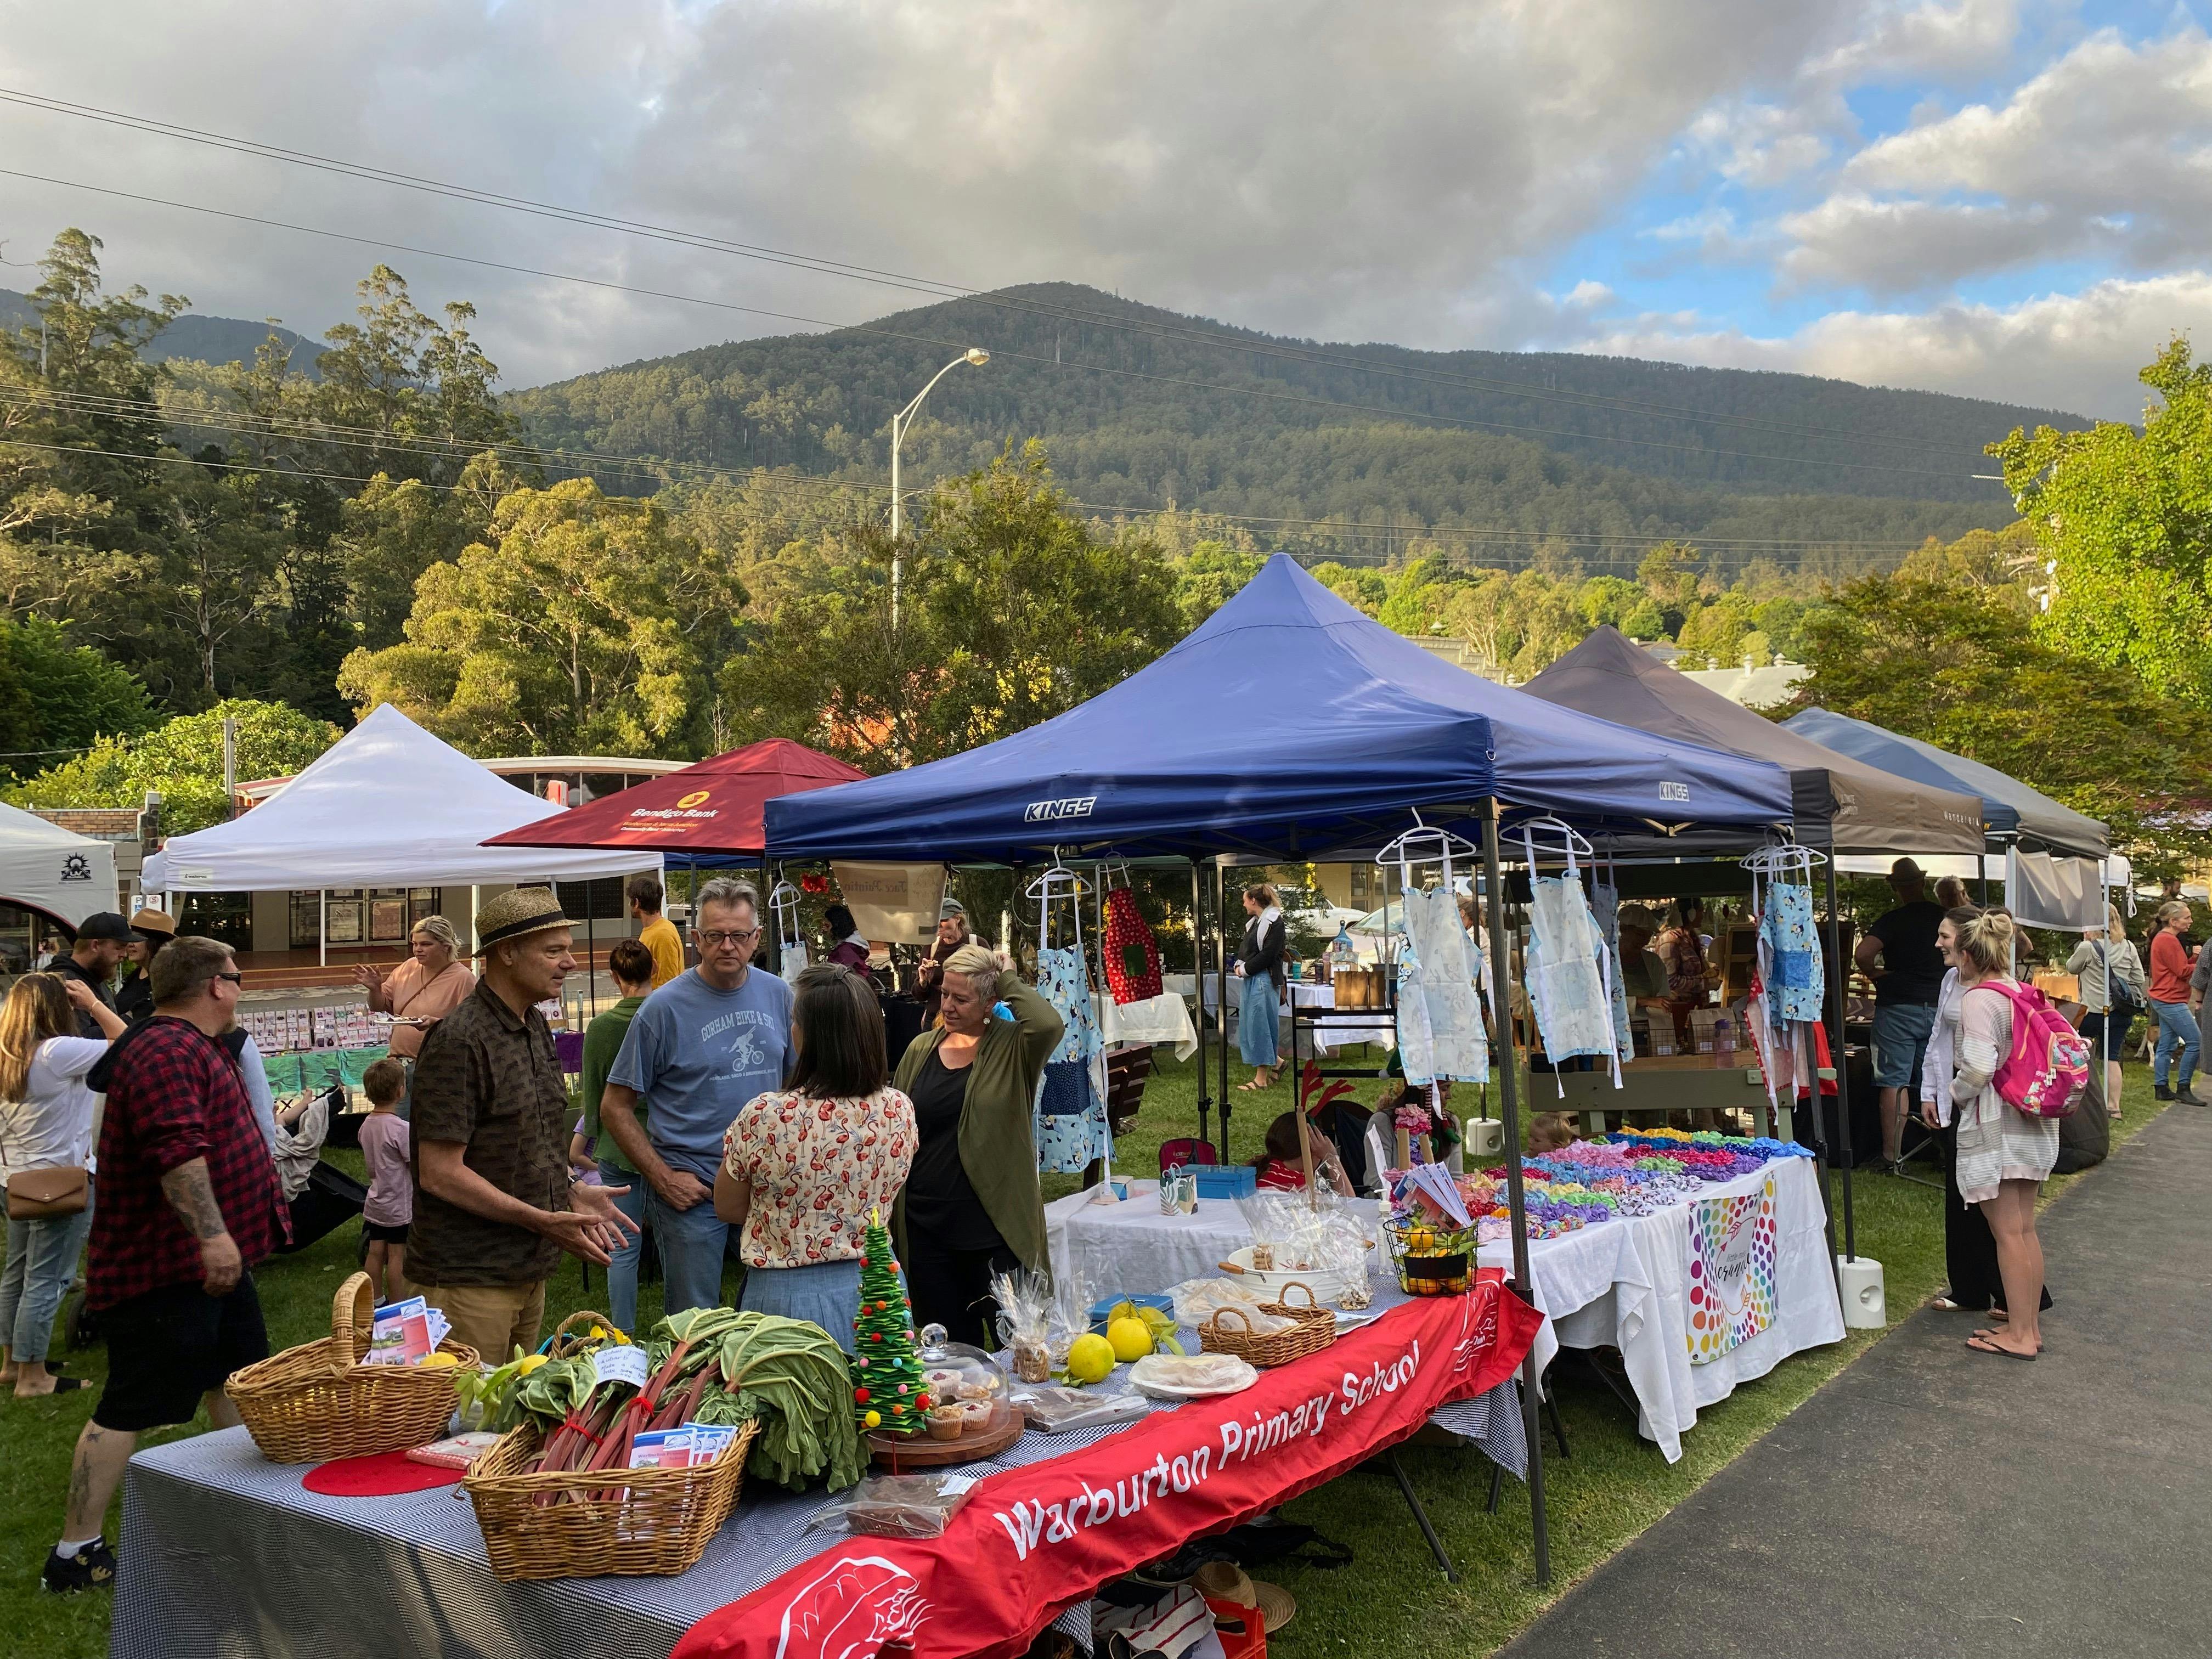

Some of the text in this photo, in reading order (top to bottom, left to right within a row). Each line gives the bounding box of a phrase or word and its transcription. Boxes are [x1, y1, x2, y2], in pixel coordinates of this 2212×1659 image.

[1660, 782, 1689, 800] KINGS
[630, 808, 719, 818] Bendigo Bank
[1025, 797, 1096, 822] KINGS
[701, 1011, 775, 1042] GORHAM BIKE & SKI
[992, 1339, 1419, 1561] Warburton Primary School
